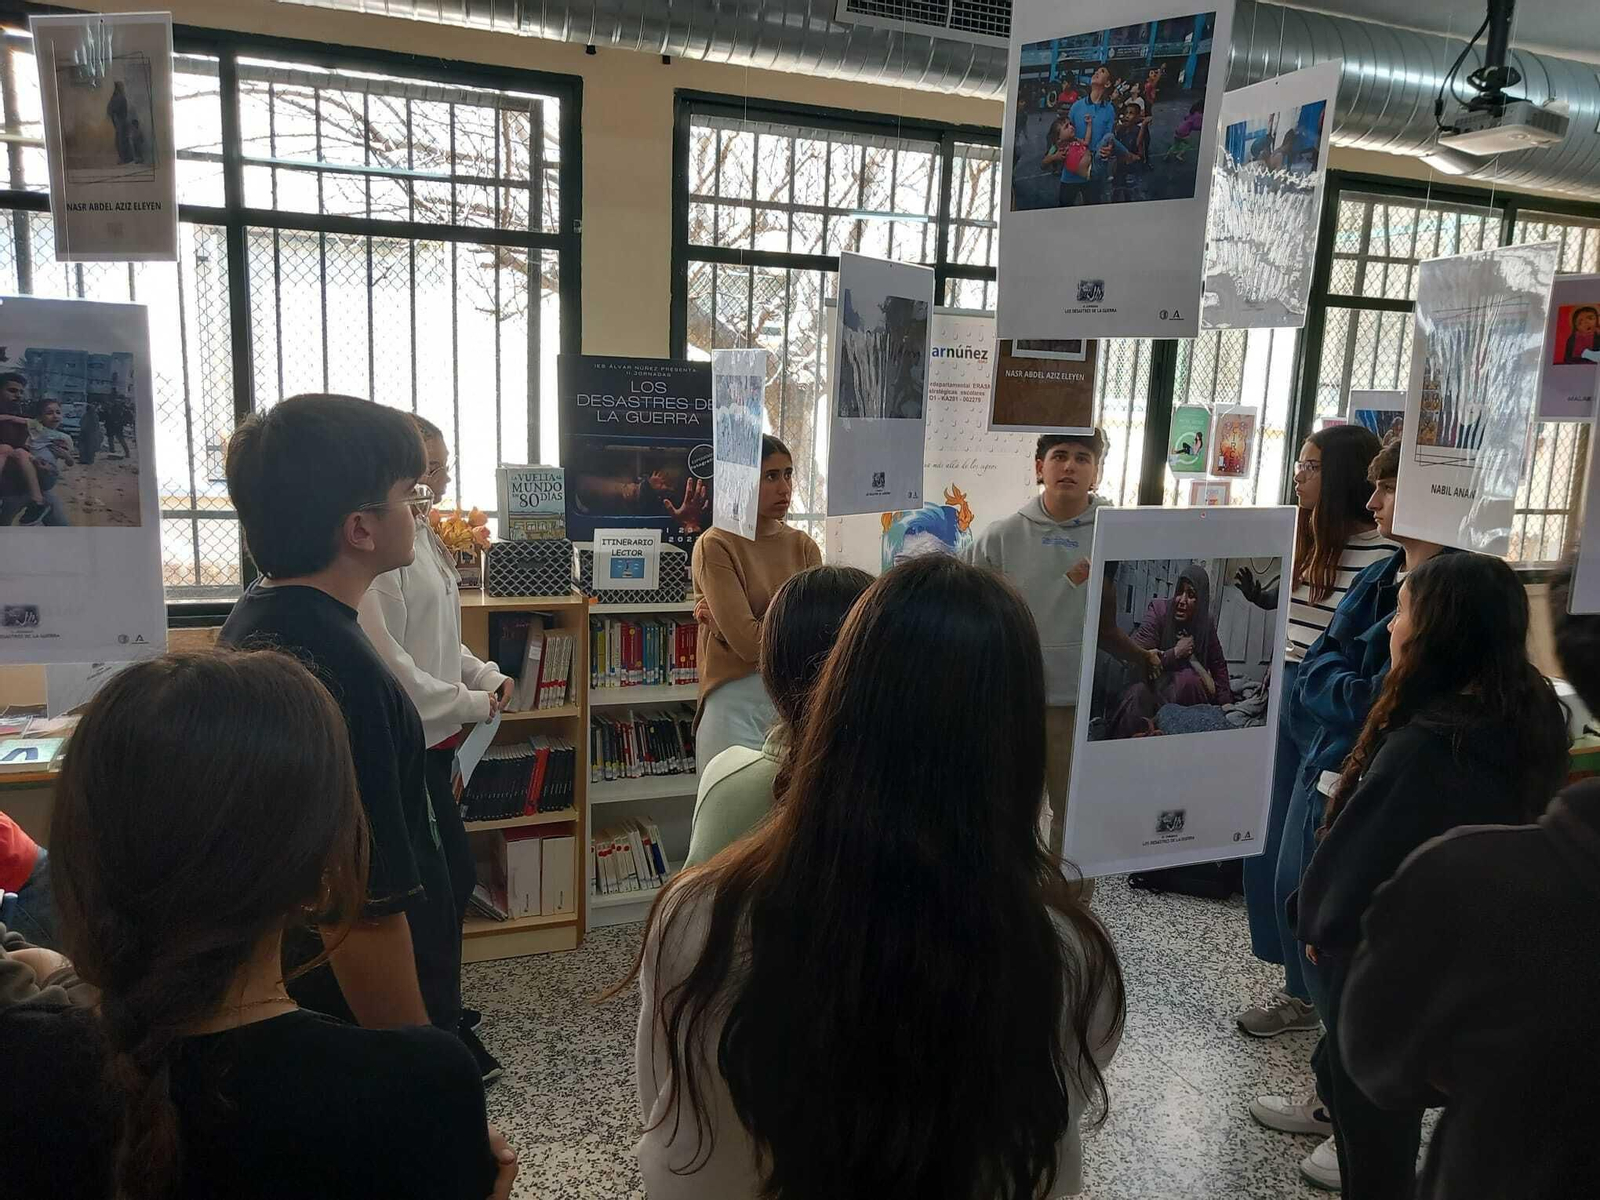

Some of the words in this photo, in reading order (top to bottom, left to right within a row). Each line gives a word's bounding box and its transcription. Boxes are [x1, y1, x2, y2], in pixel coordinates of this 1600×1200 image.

[67, 203, 87, 212] NASR
[89, 202, 113, 211] ABDEL
[115, 202, 132, 211] AZIZ
[133, 201, 162, 211] ELEYEN
[1005, 369, 1023, 378] NASR
[1024, 370, 1045, 379] ABDEL
[1046, 371, 1061, 380] AZIZ
[1061, 372, 1085, 381] ELEYEN
[630, 380, 667, 394] LOS
[577, 394, 689, 410] DESASTRES
[695, 398, 713, 411] DE
[597, 410, 620, 423] LA
[625, 410, 700, 425] GUERRA
[518, 473, 556, 481] VUELTA
[512, 482, 563, 493] MUNDO
[1431, 484, 1452, 496] NABIL
[519, 493, 540, 508] 80
[601, 538, 654, 546] ITINERARIO
[611, 549, 643, 557] LECTOR
